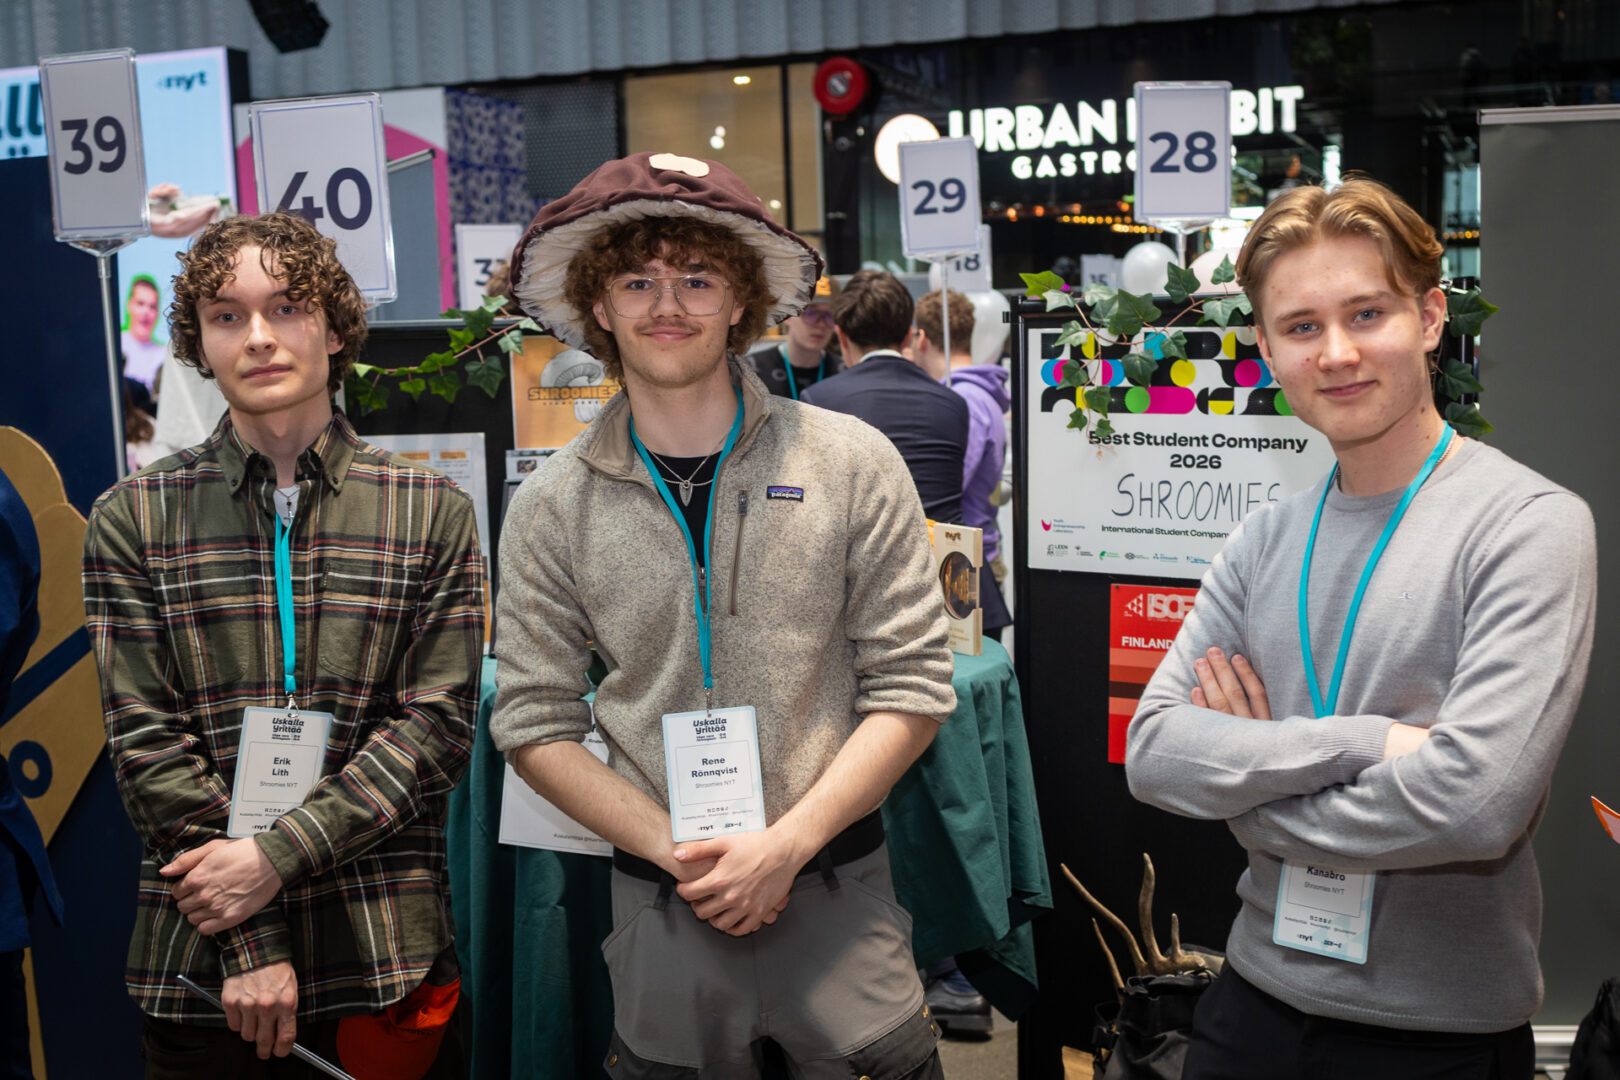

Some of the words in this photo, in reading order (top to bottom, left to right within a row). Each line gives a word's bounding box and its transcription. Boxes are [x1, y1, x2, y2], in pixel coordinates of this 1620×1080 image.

[948, 99, 1117, 152] URBAN
[61, 116, 127, 174] 39
[1148, 130, 1217, 173] 28
[276, 167, 372, 230] 40
[911, 177, 967, 215] 29
[528, 386, 619, 400] SHROOMIES
[1089, 431, 1130, 445] Best
[1133, 432, 1209, 448] Student
[1212, 433, 1308, 454] Company
[1170, 453, 1222, 469] 2026
[1101, 525, 1154, 534] International
[1155, 527, 1189, 536] Student
[272, 717, 305, 726] Uskalla
[693, 717, 727, 727] Uskalla
[273, 757, 291, 765] Erik
[691, 766, 738, 778] Rönnqvist
[1306, 865, 1346, 881] Kanabro
